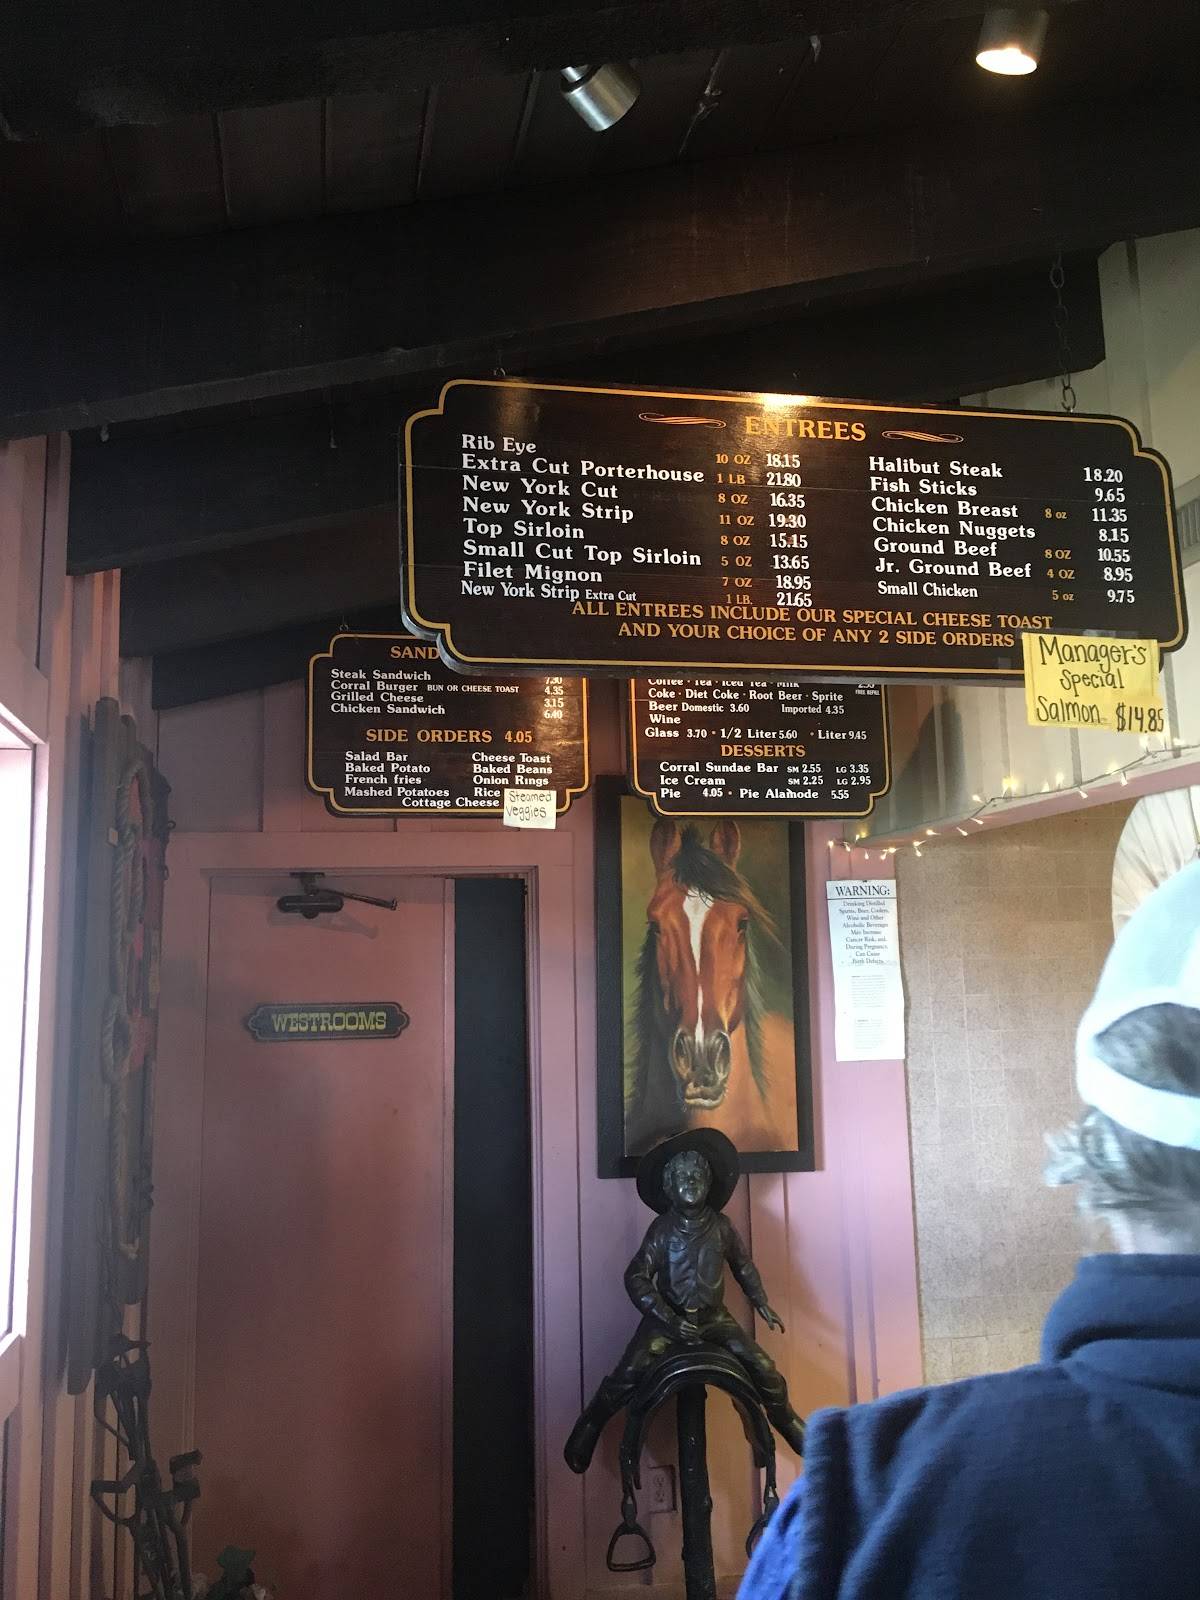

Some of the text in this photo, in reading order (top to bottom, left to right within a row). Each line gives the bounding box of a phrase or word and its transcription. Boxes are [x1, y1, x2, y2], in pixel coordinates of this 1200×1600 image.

[745, 416, 866, 441] ENTREES
[462, 434, 537, 454] Rib Eye
[462, 454, 704, 483] Extra Cut Porterhouse
[715, 453, 801, 469] 10 OZ 18.15
[869, 456, 1003, 478] Halibut Steak
[1083, 467, 1123, 483] 18.20
[463, 475, 618, 499] New York Cut
[870, 476, 977, 497] Fish Sticks
[770, 493, 805, 509] 16.35
[1094, 488, 1125, 503] 9.65
[463, 497, 634, 523] New York Strip
[871, 497, 1018, 518] Chicken Breast
[768, 513, 806, 529] 19.30
[1092, 508, 1127, 523] 11.35
[463, 518, 584, 539] Top Sirloin
[872, 517, 1036, 541] Chicken Nuggets
[769, 534, 808, 549] 15.15
[1099, 529, 1129, 544] 8.15
[463, 539, 702, 566] Small Cut Top Sirloin
[874, 537, 998, 557] Ground Beef
[773, 555, 810, 570] 13.65
[1097, 548, 1130, 563] 10.55
[463, 561, 603, 585] Filet Mignon
[875, 558, 1032, 578] Jr. Ground Beef
[1047, 567, 1133, 582] 4 OZ 8.95
[722, 575, 812, 590] 7 OZ 18.95
[877, 580, 978, 598] Small Chicken
[461, 580, 637, 602] New York Strip Extra Cut
[1107, 588, 1135, 603] 9.75
[571, 601, 1052, 629] ALL ENTREES INCLUDE OUR SPECIAL CHEESE TOAST
[618, 622, 1015, 648] AND YOUR CHOICE OF ANY 2 SIDE ORDERS
[1038, 635, 1147, 674] Manager's
[331, 669, 431, 681] Steak Sandwich
[1059, 668, 1124, 697] Special
[331, 680, 371, 691] Corral
[377, 681, 418, 693] Burger
[544, 686, 564, 696] 4.35
[331, 691, 424, 703] Grilled Cheese
[648, 689, 843, 703] Coke Diet Coke Root Beer Sprite
[331, 703, 445, 715] Chicken Sandwich
[649, 701, 750, 713] Beer Domestic 3.60
[781, 704, 844, 715] Imported 4.35
[1036, 696, 1164, 733] Salmon $14.85
[649, 714, 681, 724] Wine
[366, 729, 532, 743] SIDE ORDERS 4.05
[645, 727, 846, 739] Glass 3.70 1/2 Liter 5.60 Liter
[345, 751, 408, 762] Salad Bar
[472, 752, 551, 763] Cheese Toast
[721, 745, 806, 757] DESSERTS
[345, 763, 430, 773] Baked Potato
[473, 764, 552, 774] Baked Beans
[660, 762, 699, 772] Corral
[705, 762, 751, 773] Sundae
[757, 763, 778, 773] Bar
[802, 764, 821, 773] 2.55
[849, 764, 869, 774] 3.35
[345, 774, 422, 785] French fries
[473, 775, 549, 787] Onion Rings
[660, 775, 679, 785] Ice
[685, 775, 726, 785] Cream
[803, 776, 823, 785] 2.25
[851, 776, 871, 785] 2.95
[344, 787, 449, 797] Mashed Potatoes
[474, 787, 501, 797] Rice
[508, 791, 552, 803] Steamed
[661, 789, 681, 799] Pie
[702, 788, 723, 797] 4.05
[740, 789, 760, 799] Pie
[402, 797, 499, 809] Cottage Cheese
[835, 886, 890, 896] WARNING:
[271, 1012, 387, 1032] WESTROOMS
